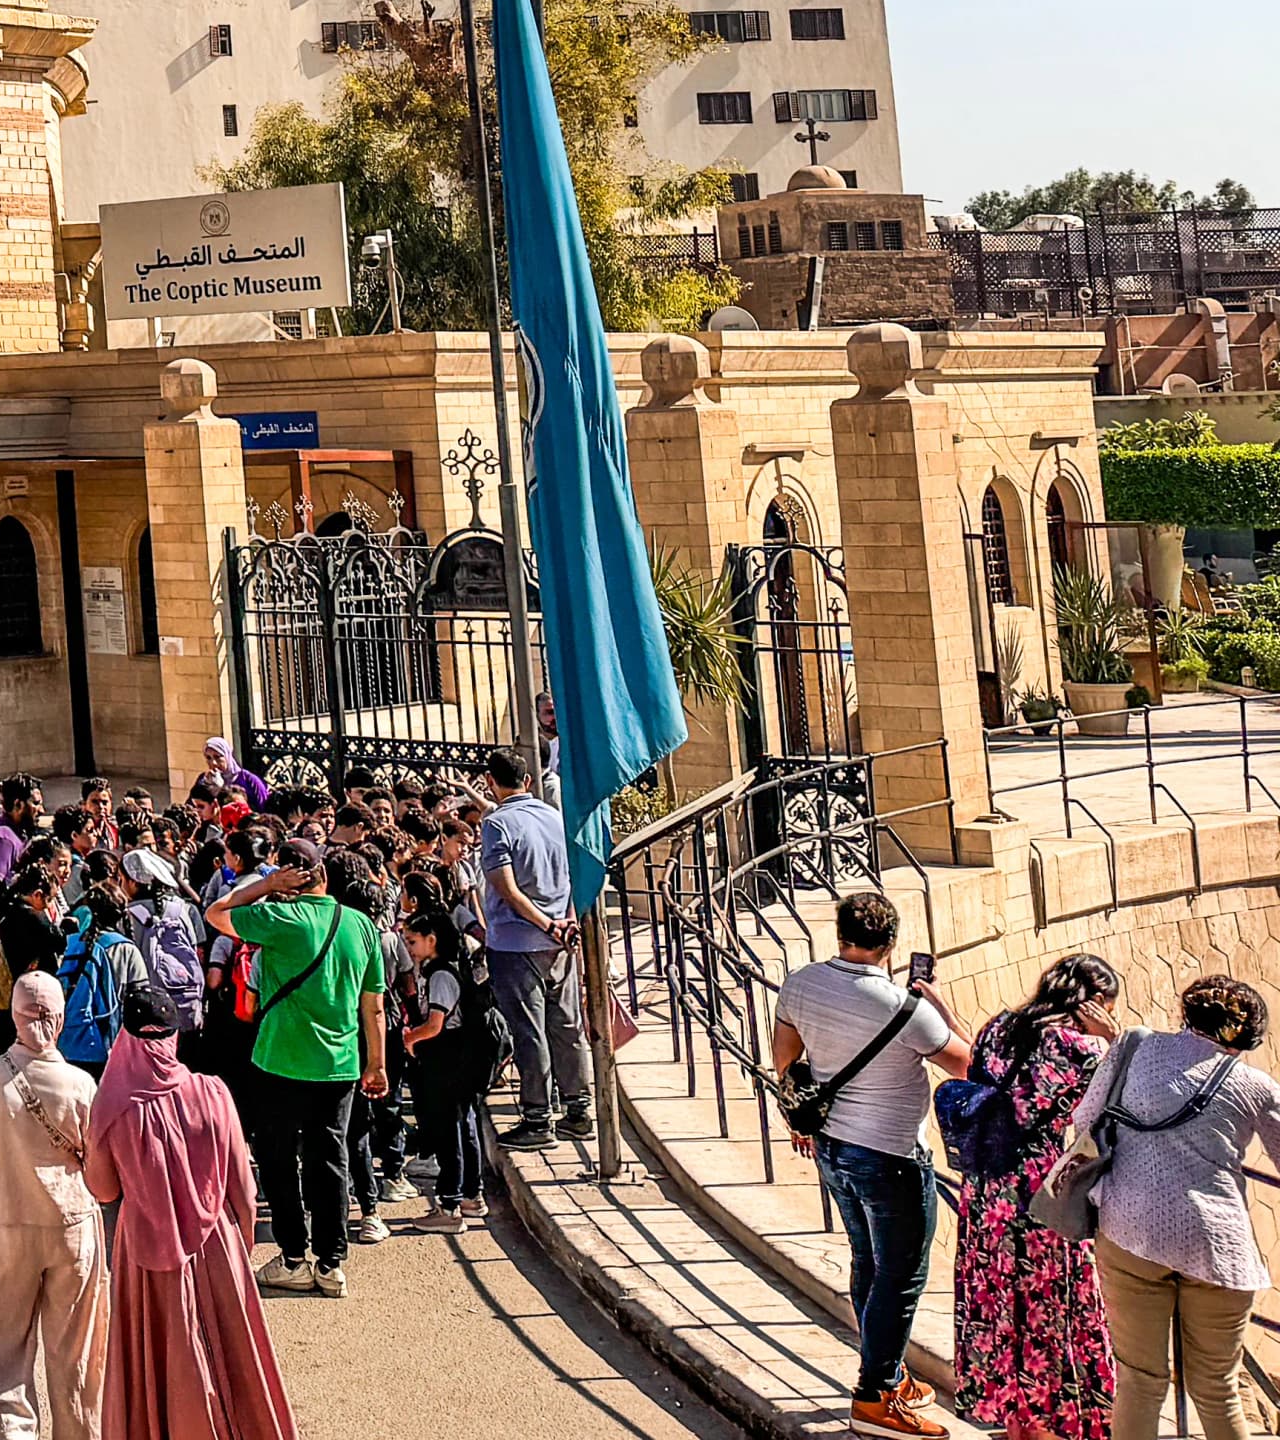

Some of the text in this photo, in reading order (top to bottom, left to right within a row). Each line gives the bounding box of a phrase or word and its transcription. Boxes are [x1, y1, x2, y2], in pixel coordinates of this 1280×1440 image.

[135, 237, 305, 281] المتحف القبطي
[124, 275, 323, 304] The Coptic Museum
